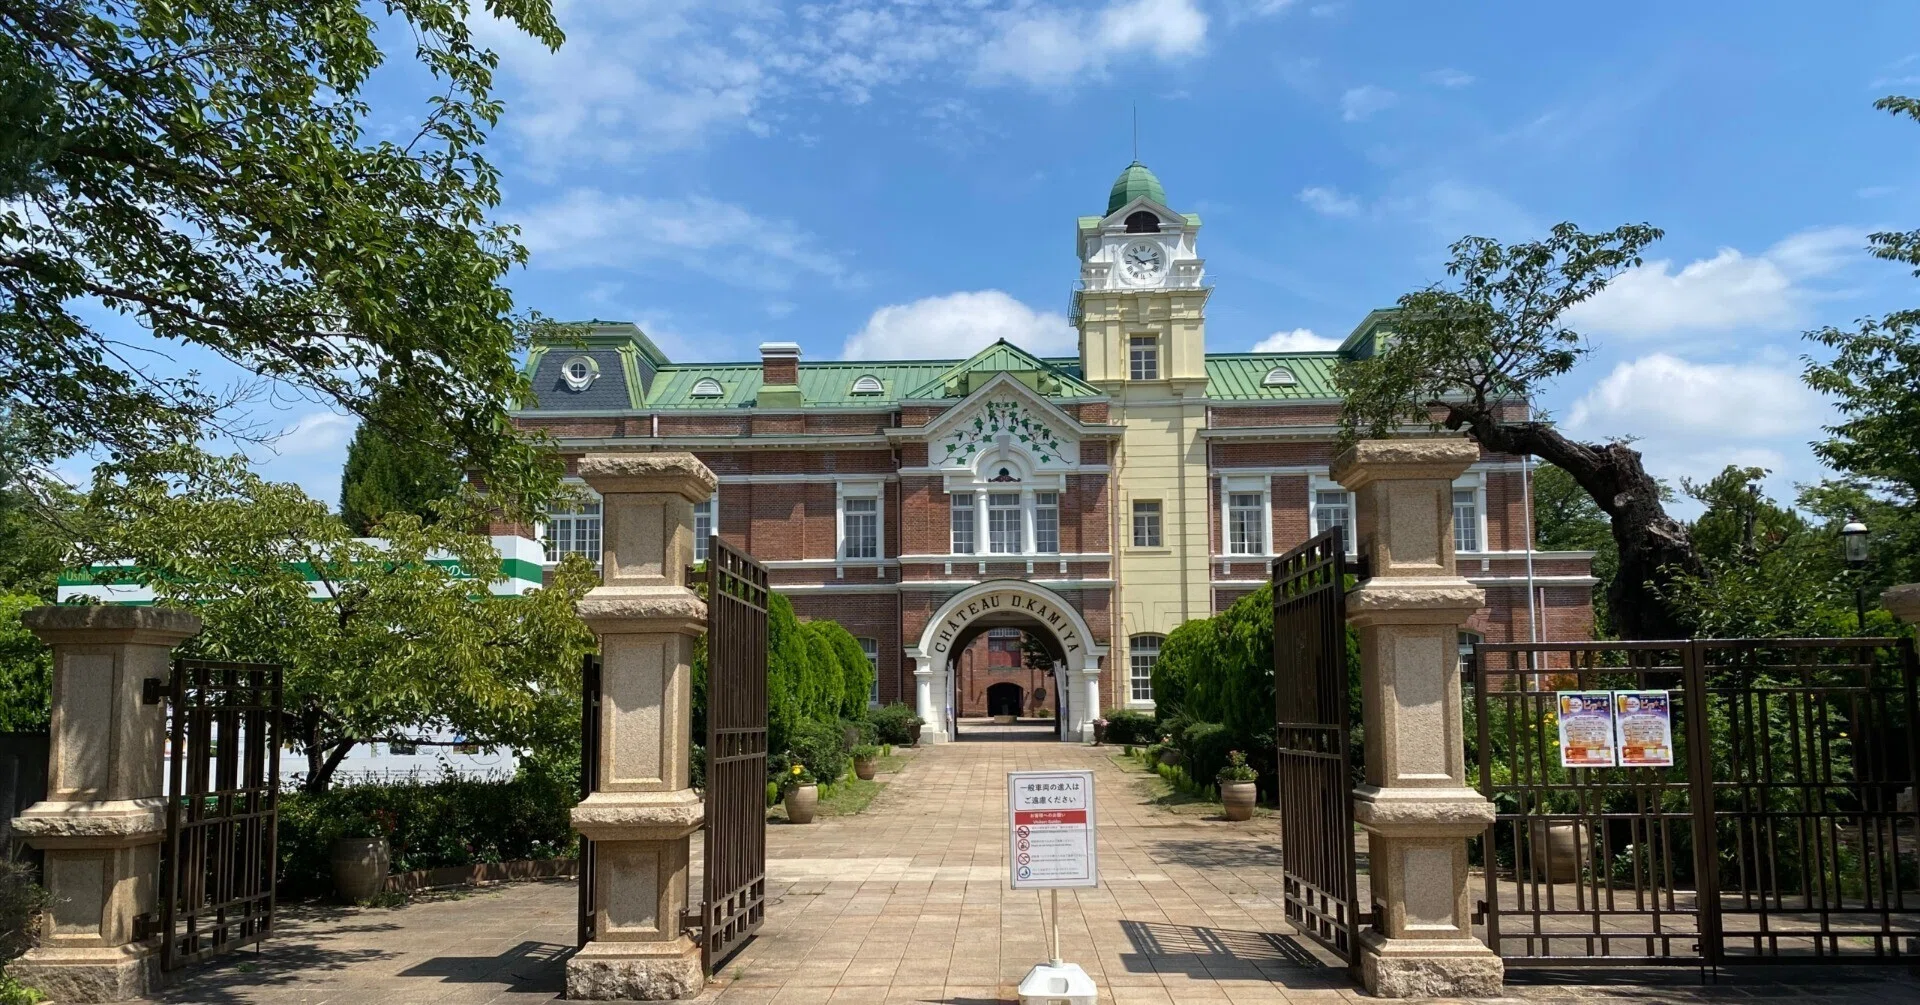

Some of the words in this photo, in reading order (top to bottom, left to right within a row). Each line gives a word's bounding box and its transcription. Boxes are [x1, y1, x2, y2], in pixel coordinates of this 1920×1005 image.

[1020, 783, 1080, 792] 一般車両の進入は
[1024, 796, 1077, 805] ご遠慮ください
